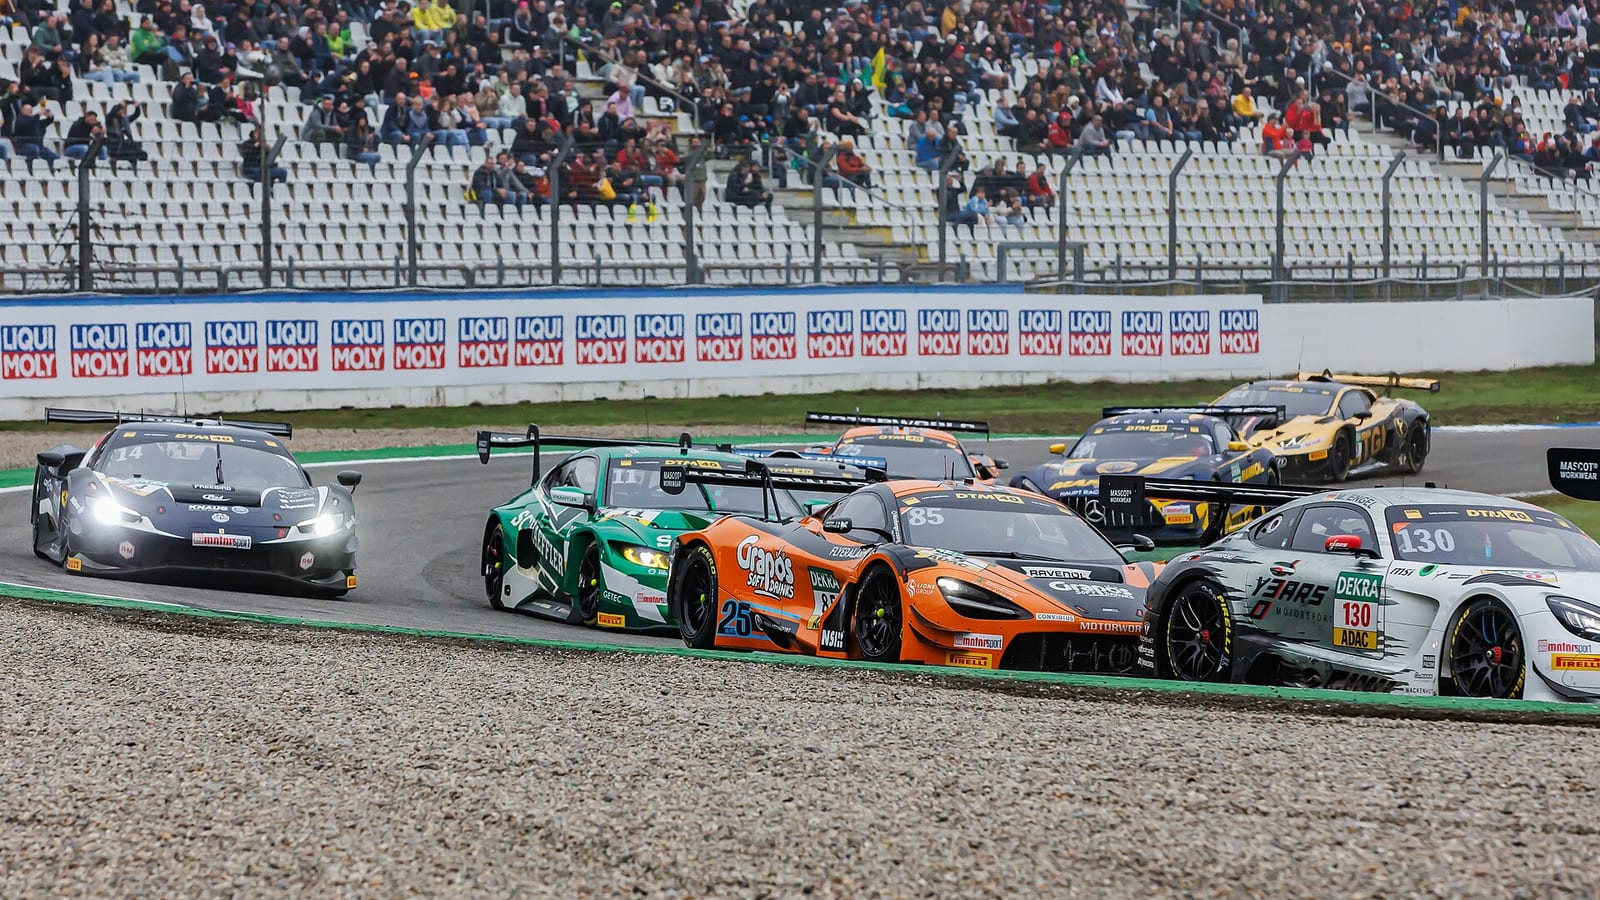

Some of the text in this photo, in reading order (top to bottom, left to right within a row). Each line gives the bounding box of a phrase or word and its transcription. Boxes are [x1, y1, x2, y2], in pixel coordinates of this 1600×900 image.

[394, 319, 446, 344] LIQUI
[458, 318, 508, 342] LIQUI
[515, 316, 563, 341] LIQUI
[576, 315, 625, 340] LIQUI
[635, 314, 685, 338] LIQUI
[696, 314, 741, 338] LIQUI
[751, 313, 795, 336] LIQUI
[807, 311, 853, 334] LIQUI
[861, 309, 906, 333] LIQUI
[918, 309, 959, 333] LIQUI
[968, 310, 1007, 333] LIQUI
[1019, 310, 1062, 333] LIQUI
[1070, 311, 1111, 334] LIQUI
[1122, 312, 1162, 334] LIQUI
[1170, 311, 1209, 333] LIQUI
[1220, 311, 1256, 332] LIQUI
[1, 326, 55, 352] LIQUI
[70, 324, 127, 350] LIQUI
[136, 322, 191, 348] LIQUI
[205, 321, 258, 347] LIQUI
[266, 321, 318, 346] LIQUI
[331, 320, 384, 346] LIQUI
[863, 334, 906, 355] MOLY
[919, 334, 959, 354] MOLY
[969, 334, 1007, 354] MOLY
[1021, 334, 1061, 354] MOLY
[1172, 334, 1209, 354] MOLY
[1221, 333, 1258, 352] MOLY
[460, 343, 507, 366] MOLY
[516, 342, 562, 365] MOLY
[577, 341, 625, 363] MOLY
[636, 339, 684, 362] MOLY
[698, 339, 742, 360] MOLY
[752, 337, 795, 359] MOLY
[808, 335, 853, 357] MOLY
[1070, 335, 1110, 355] MOLY
[1123, 335, 1162, 355] MOLY
[2, 353, 56, 379] MOLY
[71, 351, 128, 377] MOLY
[137, 349, 191, 375] MOLY
[207, 348, 257, 373] MOLY
[267, 347, 317, 371] MOLY
[332, 347, 384, 370] MOLY
[395, 345, 444, 369] MOLY
[116, 446, 143, 462] 14
[1560, 472, 1597, 480] WORKWEAR
[1347, 494, 1376, 509] ENGEL
[908, 508, 944, 526] 85
[1400, 528, 1455, 552] 130
[747, 573, 765, 588] SOFT
[810, 570, 840, 589] DEKRA
[1030, 570, 1086, 579] RAVENOL
[1390, 568, 1414, 576] msi
[603, 590, 623, 603] GETEC
[768, 580, 794, 598] DRINKS
[1337, 576, 1379, 598] DEKRA
[717, 598, 752, 638] 25
[1217, 595, 1231, 654] PIRELLI
[1343, 602, 1370, 627] 130
[963, 638, 1001, 648] motorsport
[1341, 630, 1369, 647] ADAC
[1548, 641, 1592, 653] motorsport
[950, 654, 988, 666] PIRELLI
[1556, 657, 1600, 668] PIRELLI
